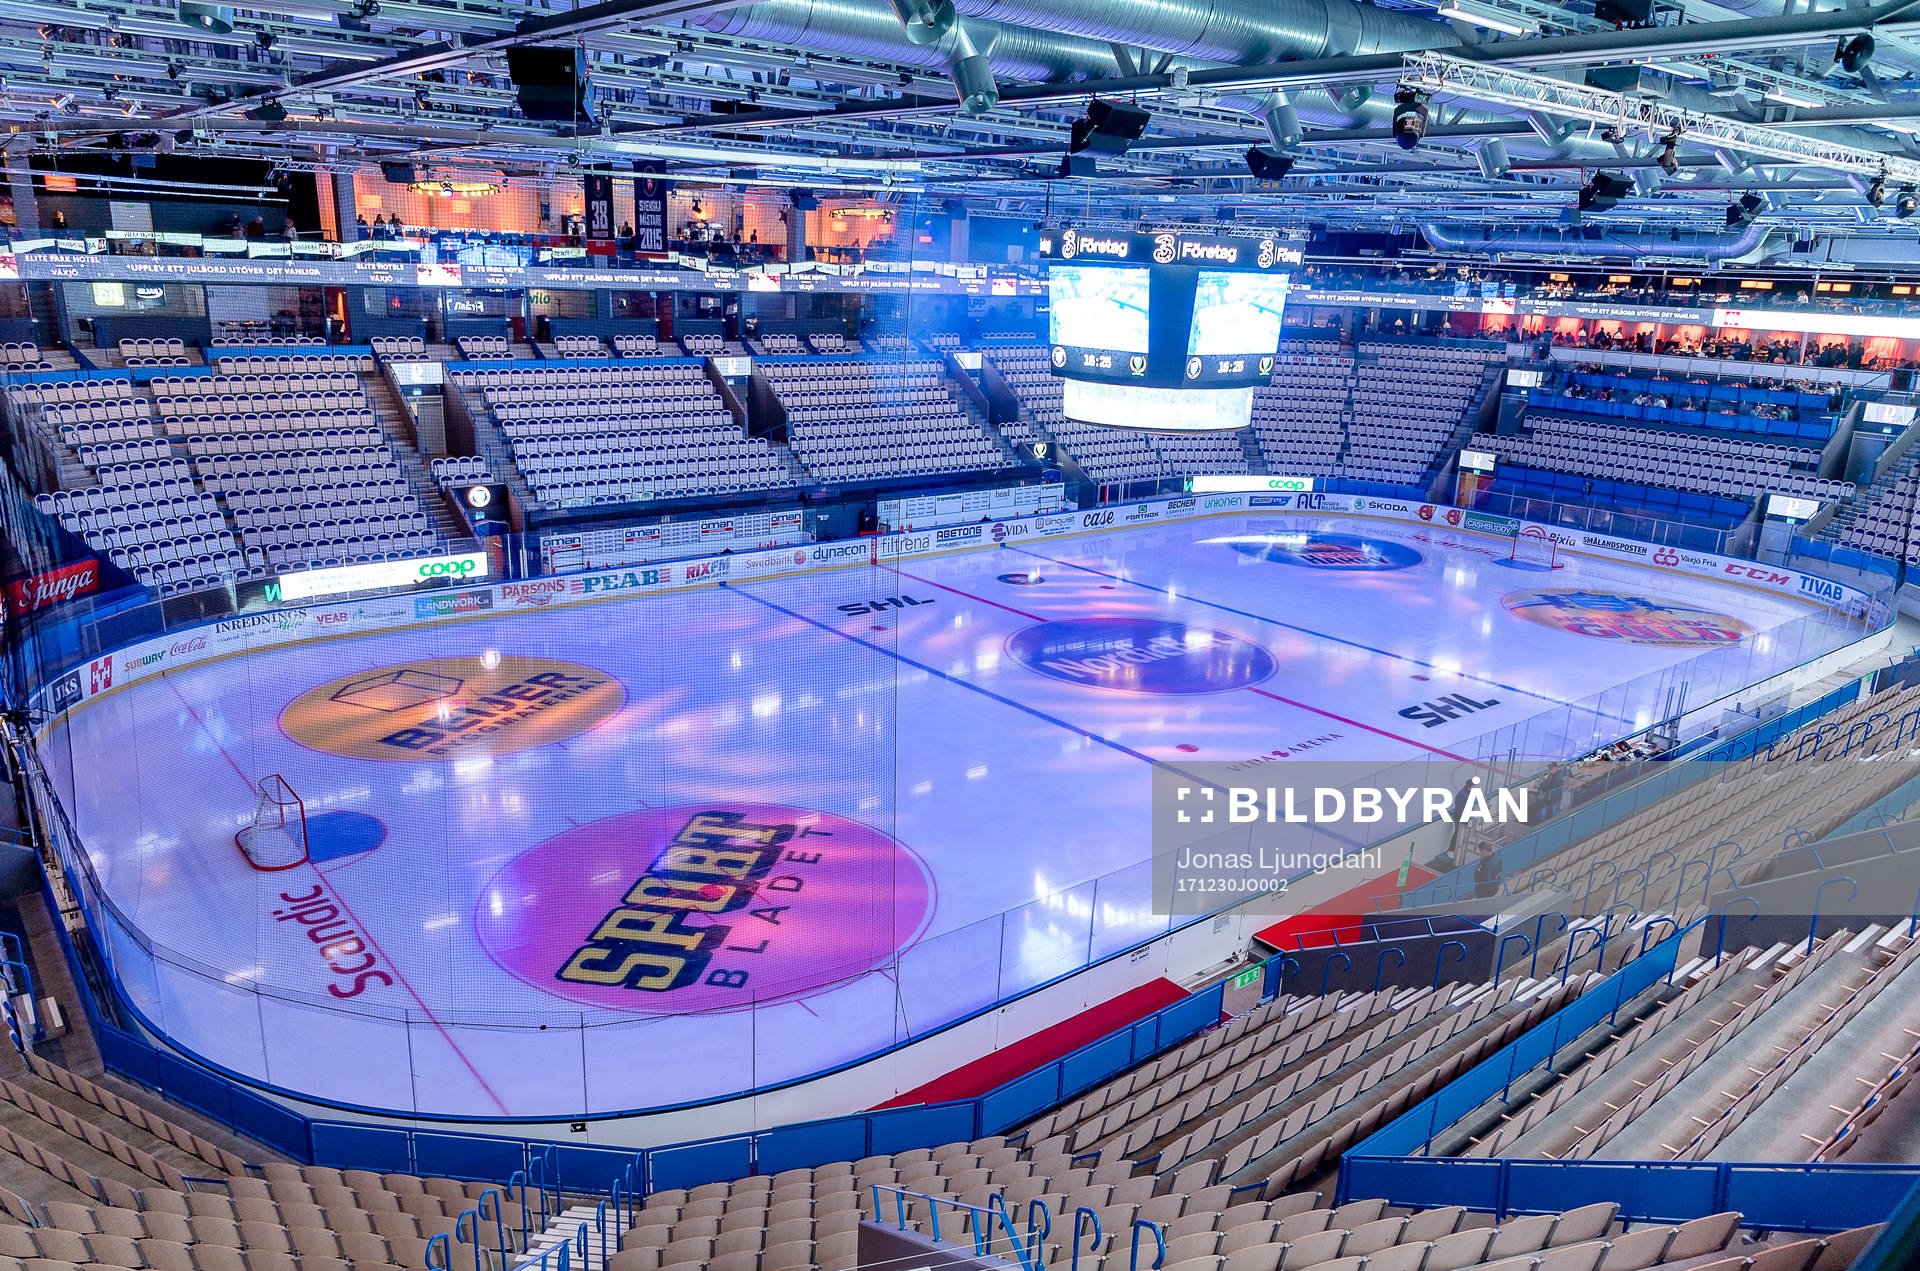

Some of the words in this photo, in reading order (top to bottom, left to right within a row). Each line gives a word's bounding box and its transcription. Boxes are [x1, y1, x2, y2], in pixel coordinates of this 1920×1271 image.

[591, 200, 609, 230] 38
[638, 200, 662, 212] SVENSKA
[640, 228, 663, 250] 2015
[1080, 237, 1128, 258] Företag
[72, 256, 100, 264] HOTEL
[1182, 242, 1237, 263] Företag
[167, 265, 184, 273] ETT
[186, 266, 226, 274] JULBORD
[229, 266, 264, 274] UTÖVER
[266, 267, 282, 275] DET
[284, 268, 320, 276] VANLIGA
[995, 489, 1010, 498] head
[1268, 480, 1305, 492] coop
[1168, 498, 1197, 510] BECHEM
[1368, 500, 1408, 513] ŠKODA
[701, 518, 734, 531] öman
[1083, 510, 1114, 528] case
[1126, 512, 1159, 520] FORTNOX
[625, 526, 660, 538] öman
[936, 526, 982, 539] ABETONG
[1006, 524, 1029, 536] VIDA
[1466, 518, 1512, 535] CASHBUDDY
[542, 534, 581, 548] öman
[881, 536, 930, 554] filtrena
[1550, 532, 1577, 547] Pixia
[1582, 534, 1648, 555] SMÅLANDSPOSTEN
[812, 544, 867, 562] dynacon
[419, 558, 476, 578] coop
[746, 556, 792, 570] Swedbank
[1702, 558, 1718, 568] Fria
[583, 568, 662, 594] PEAB
[1724, 562, 1792, 586] CCM
[18, 569, 94, 611] Sjunga
[502, 579, 565, 600] PARSONS
[1800, 575, 1844, 601] TIVAB
[837, 594, 936, 617] SHL
[215, 608, 308, 634] INREDNINGS
[316, 612, 348, 626] VEAB
[1564, 622, 1742, 641] GULD
[124, 650, 167, 672] SUBWAY
[56, 678, 78, 702] JKS
[376, 670, 586, 750] BEIJER
[426, 678, 607, 756] BYGGMATERIAL
[1398, 692, 1501, 728] SHL
[1226, 754, 1276, 773] VIDA
[1287, 732, 1344, 754] ARENA
[555, 811, 799, 993] SPORT
[704, 826, 835, 989] BLADET
[272, 884, 394, 999] Scandic
